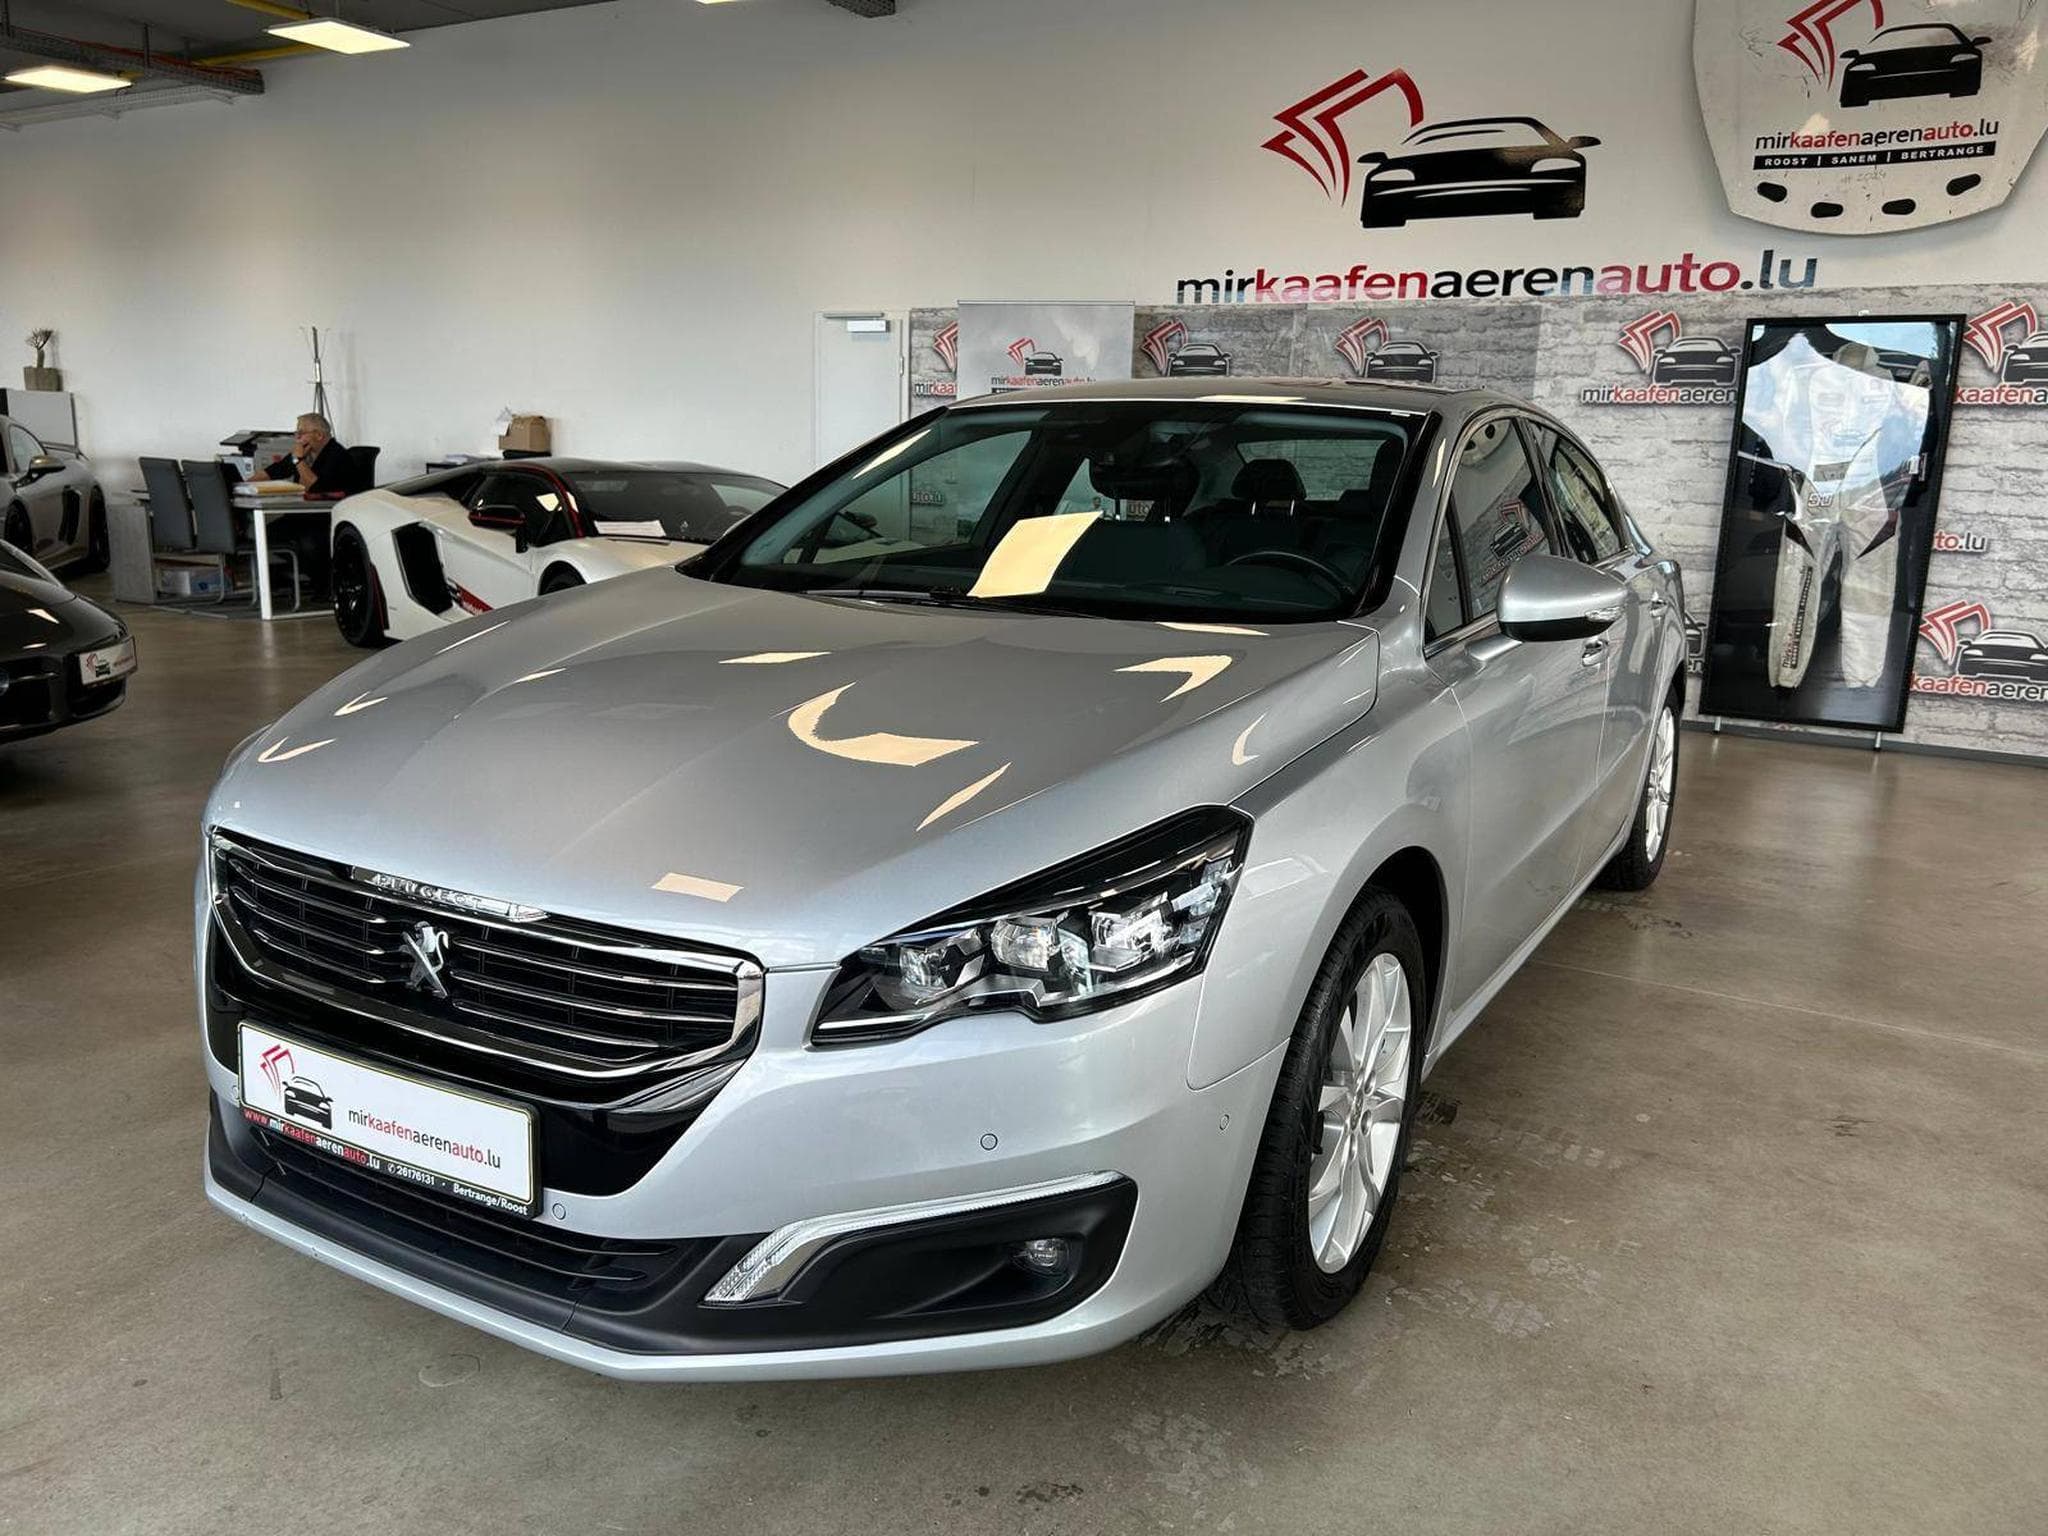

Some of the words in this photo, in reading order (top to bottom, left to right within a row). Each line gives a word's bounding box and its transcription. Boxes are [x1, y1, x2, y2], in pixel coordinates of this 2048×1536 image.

[1755, 118, 1999, 150] mirkaafenaerenauto.lu
[1764, 156, 1808, 167] ROOST
[1831, 153, 1877, 165] SANEM
[1901, 145, 1985, 160] BERTRANGE
[1177, 249, 1817, 304] mirkaafenaerenauto.lu
[348, 1109, 501, 1169] mirkaafenaerenauto.lu
[396, 1165, 435, 1186] 26176131
[453, 1183, 528, 1216] Bertrange/Roost
